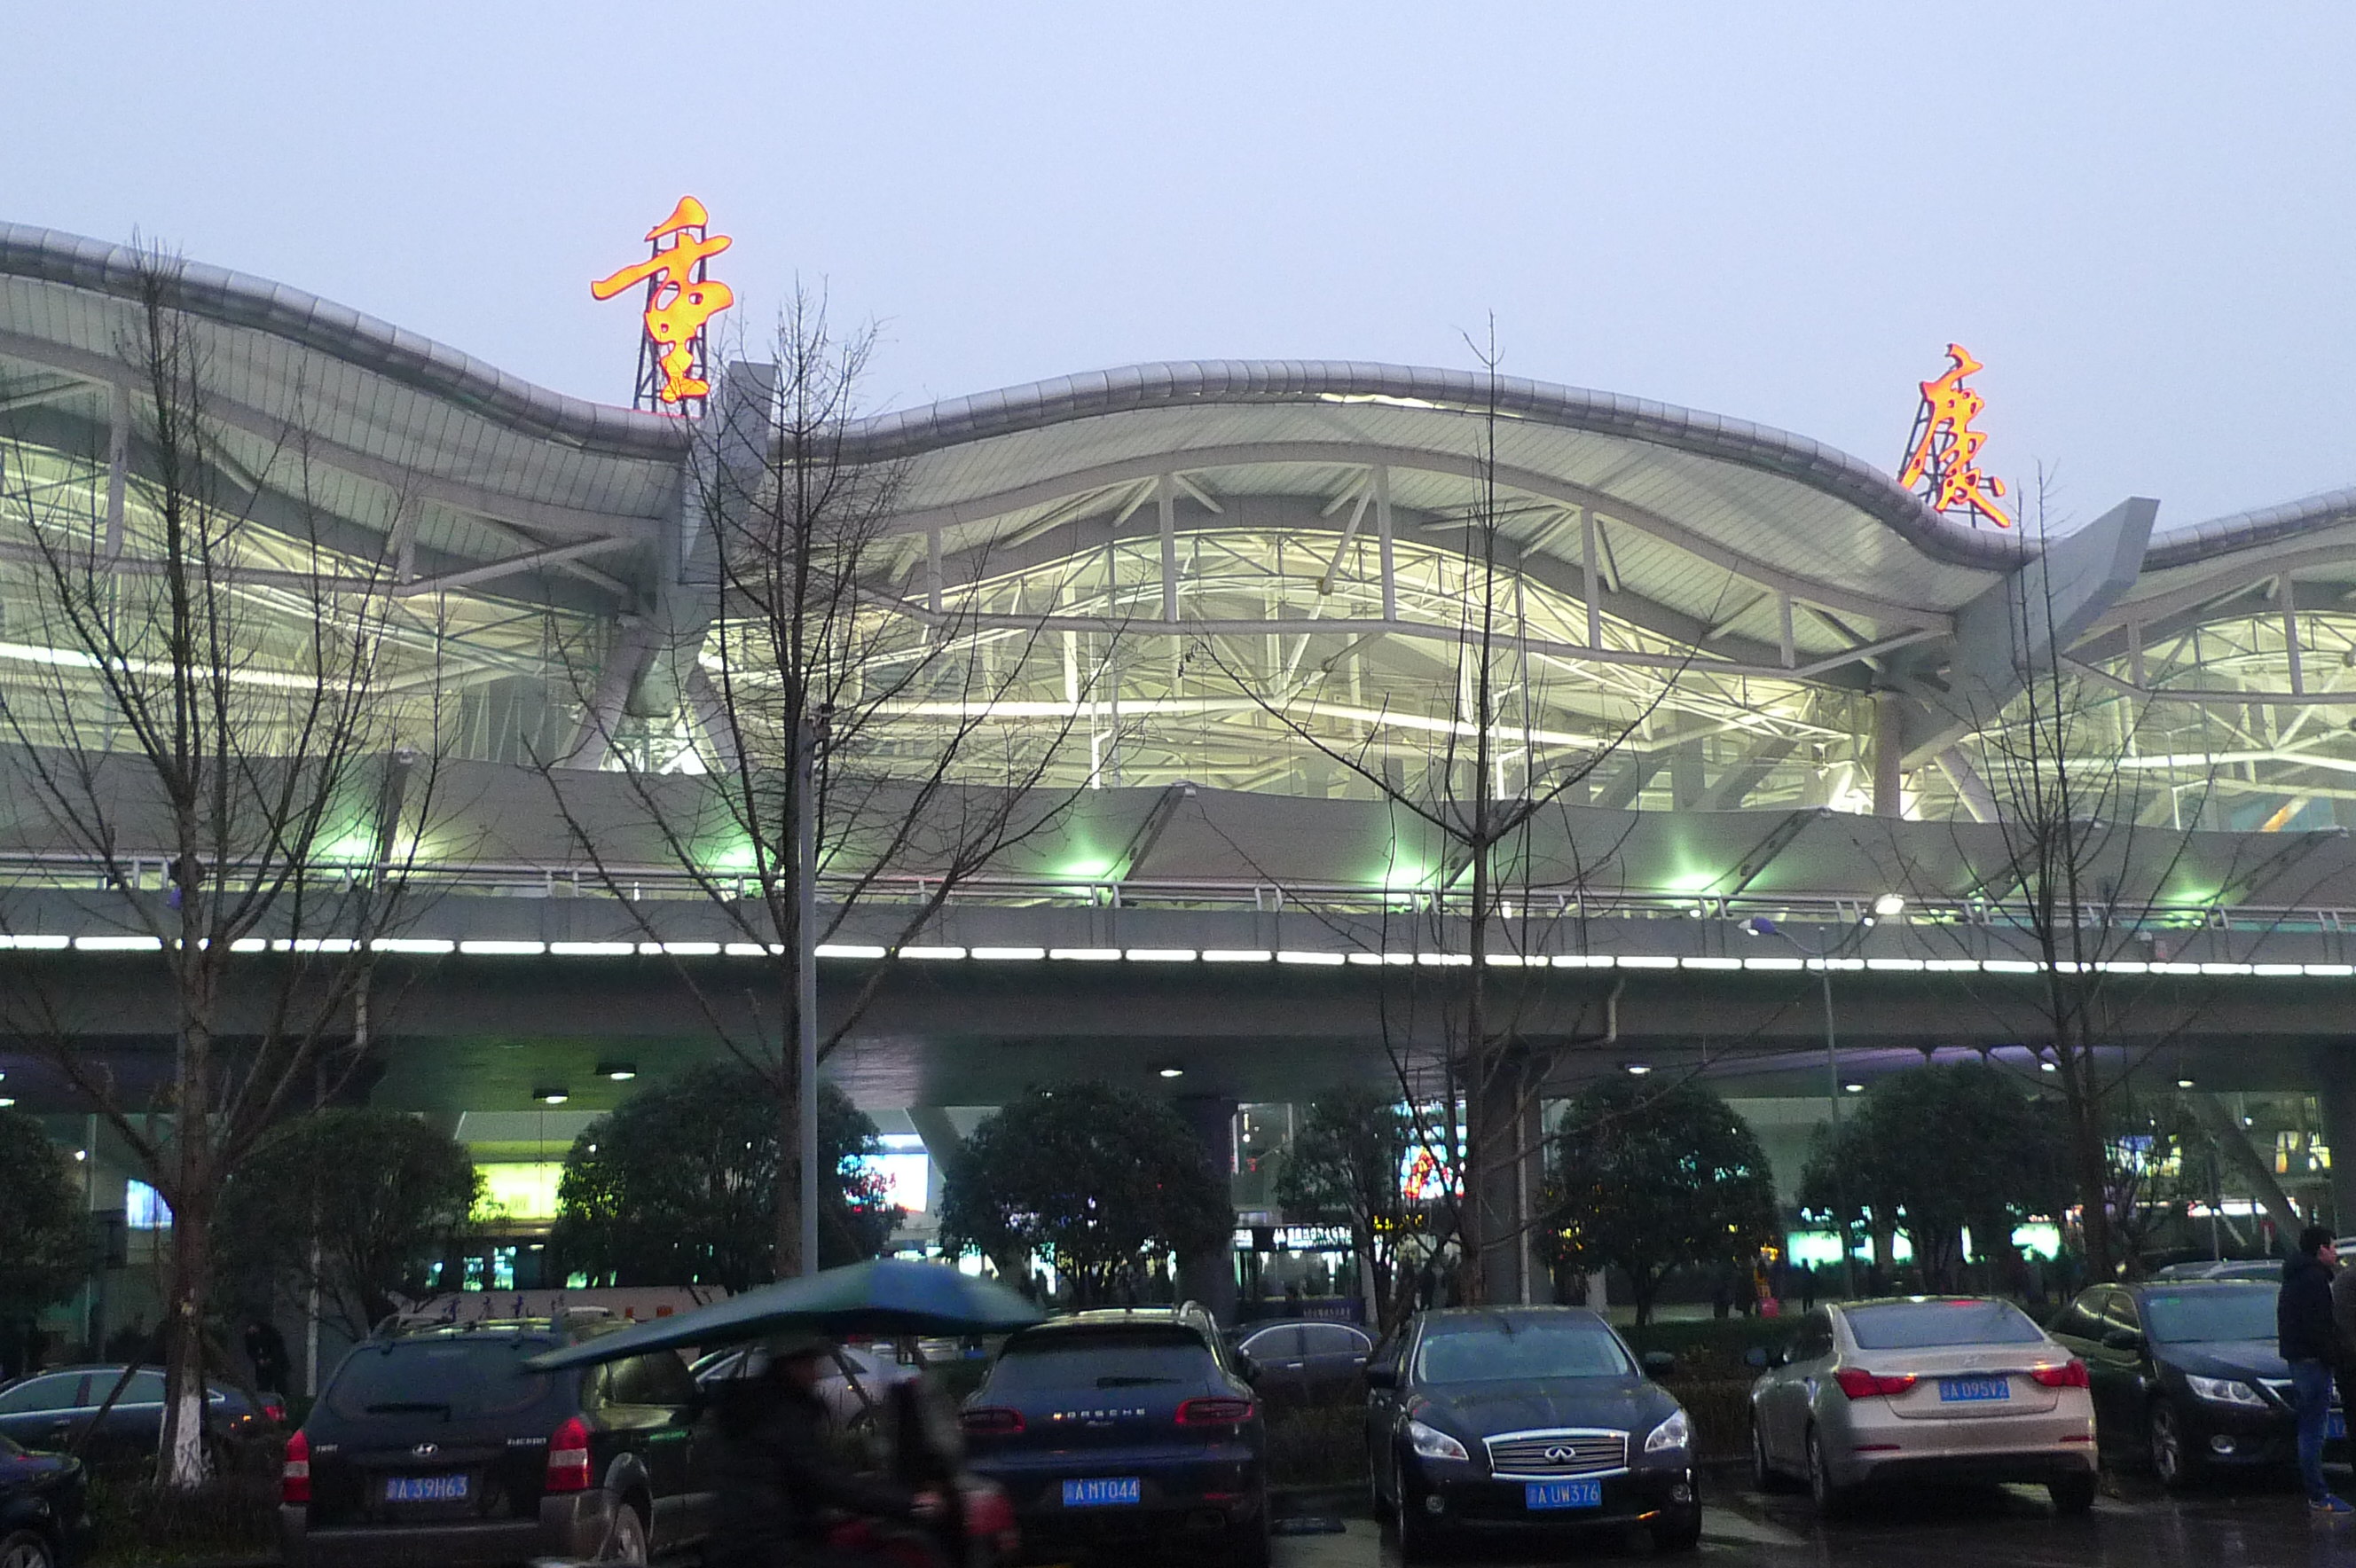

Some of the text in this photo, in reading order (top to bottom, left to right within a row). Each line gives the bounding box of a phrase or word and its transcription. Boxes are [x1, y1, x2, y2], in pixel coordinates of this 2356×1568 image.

[592, 195, 734, 404] 重
[1065, 1480, 1137, 1501] AMT044
[1527, 1484, 1598, 1504] AUW376
